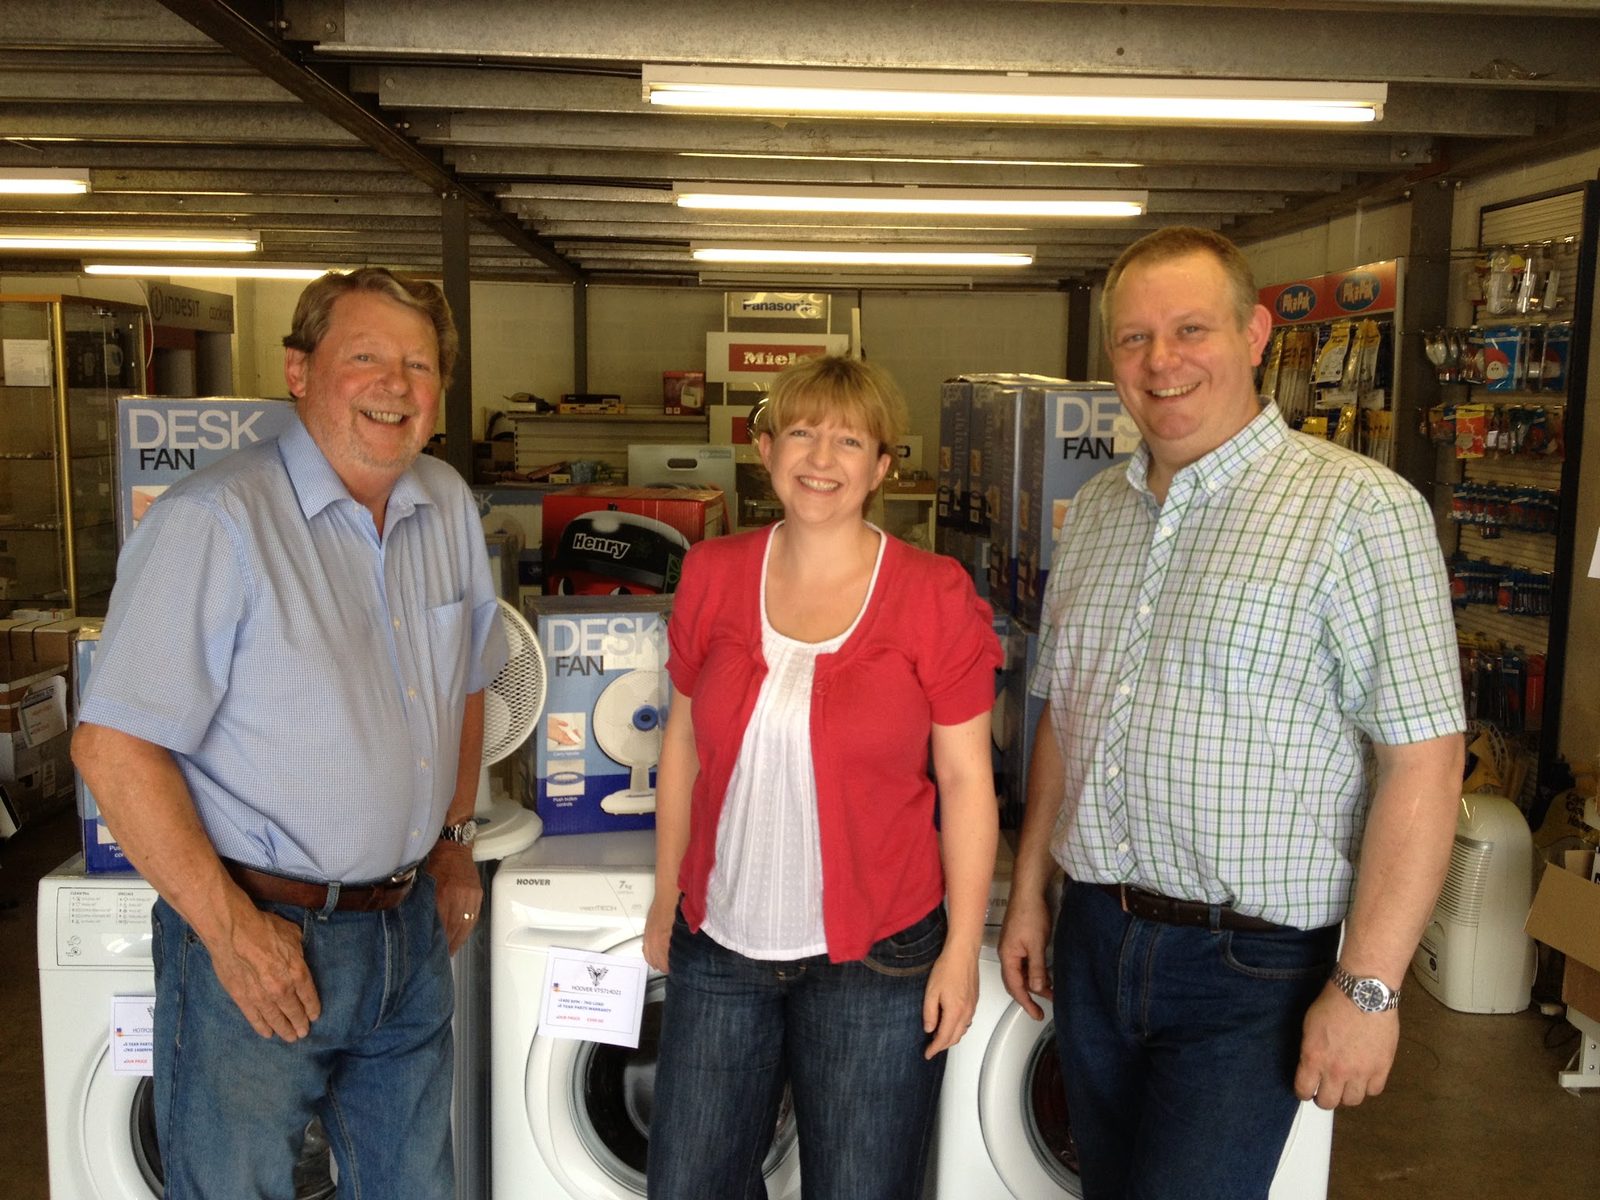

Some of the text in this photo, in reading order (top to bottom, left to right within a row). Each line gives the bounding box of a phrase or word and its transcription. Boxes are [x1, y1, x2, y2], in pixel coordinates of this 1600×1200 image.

[743, 351, 798, 366] Miel
[1055, 395, 1143, 439] DES
[128, 408, 265, 450] DESK
[140, 448, 196, 471] FAN
[1062, 437, 1115, 460] FAN
[572, 533, 631, 559] Henry
[546, 617, 659, 658] DESK
[554, 655, 605, 677] FAN
[516, 878, 551, 886] HOOVER
